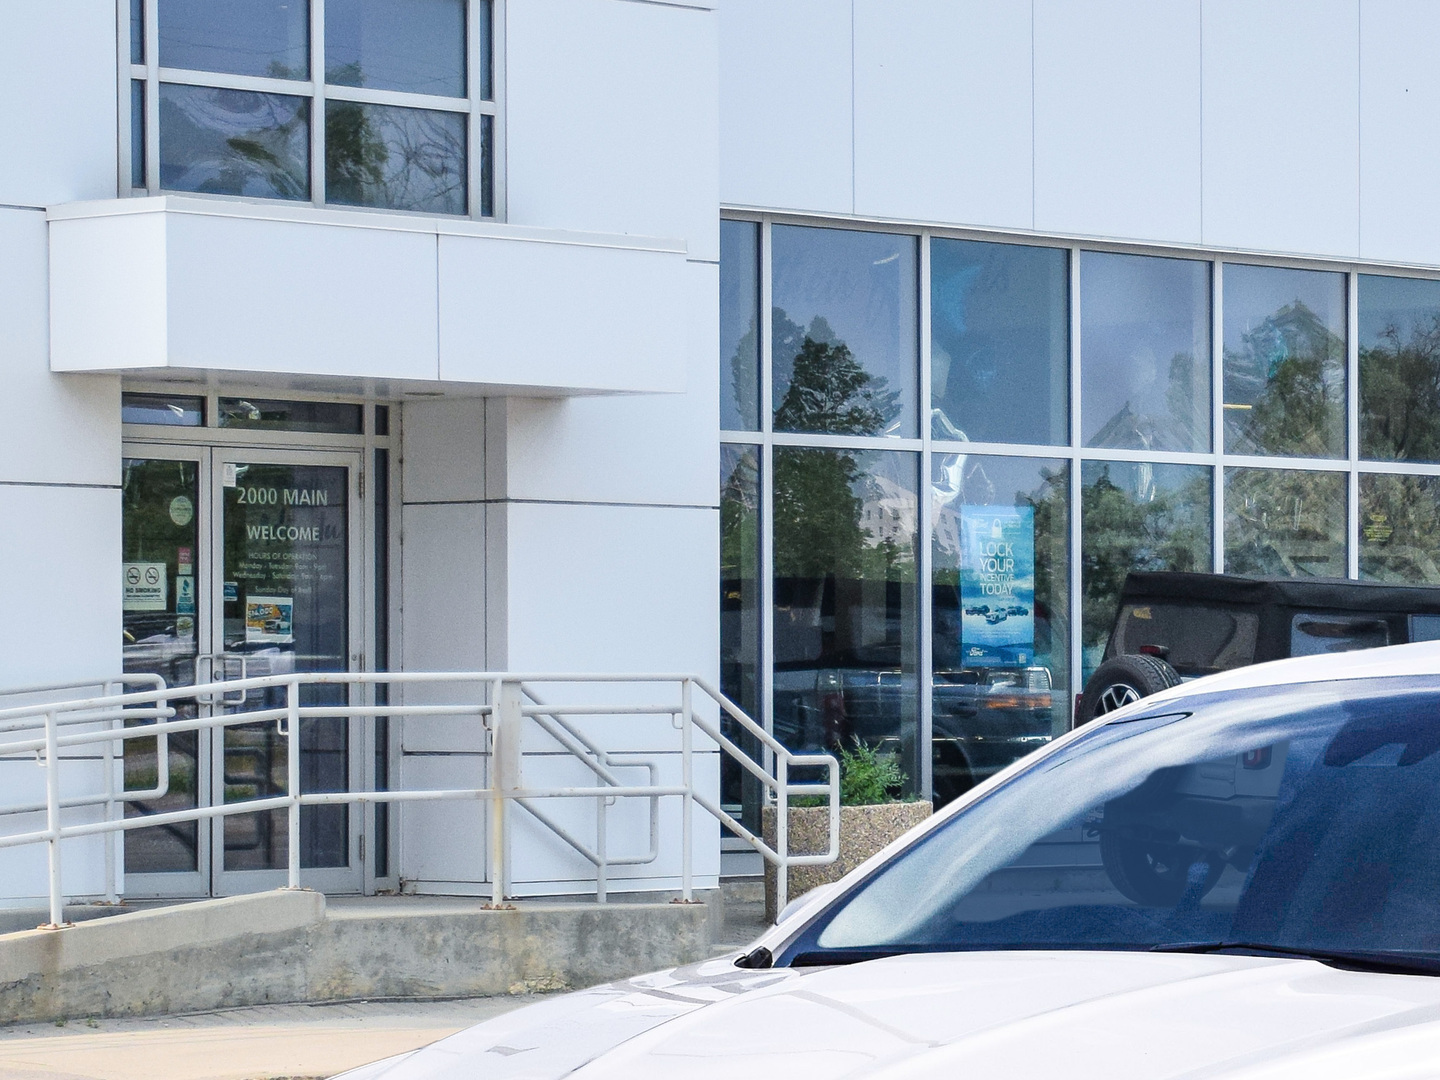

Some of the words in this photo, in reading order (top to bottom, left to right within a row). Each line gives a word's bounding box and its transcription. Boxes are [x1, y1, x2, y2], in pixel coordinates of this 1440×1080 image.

[236, 487, 278, 505] 2000
[283, 488, 328, 506] MAIN
[246, 524, 320, 541] WELCOME
[979, 541, 1014, 557] LOCK
[248, 552, 271, 560] HOURS
[272, 552, 281, 560] OF
[283, 552, 318, 561] OPERATION
[239, 562, 263, 570] Monday
[979, 558, 1015, 572] YOUR
[232, 571, 266, 580] Wednesday
[980, 583, 1014, 595] TODAY
